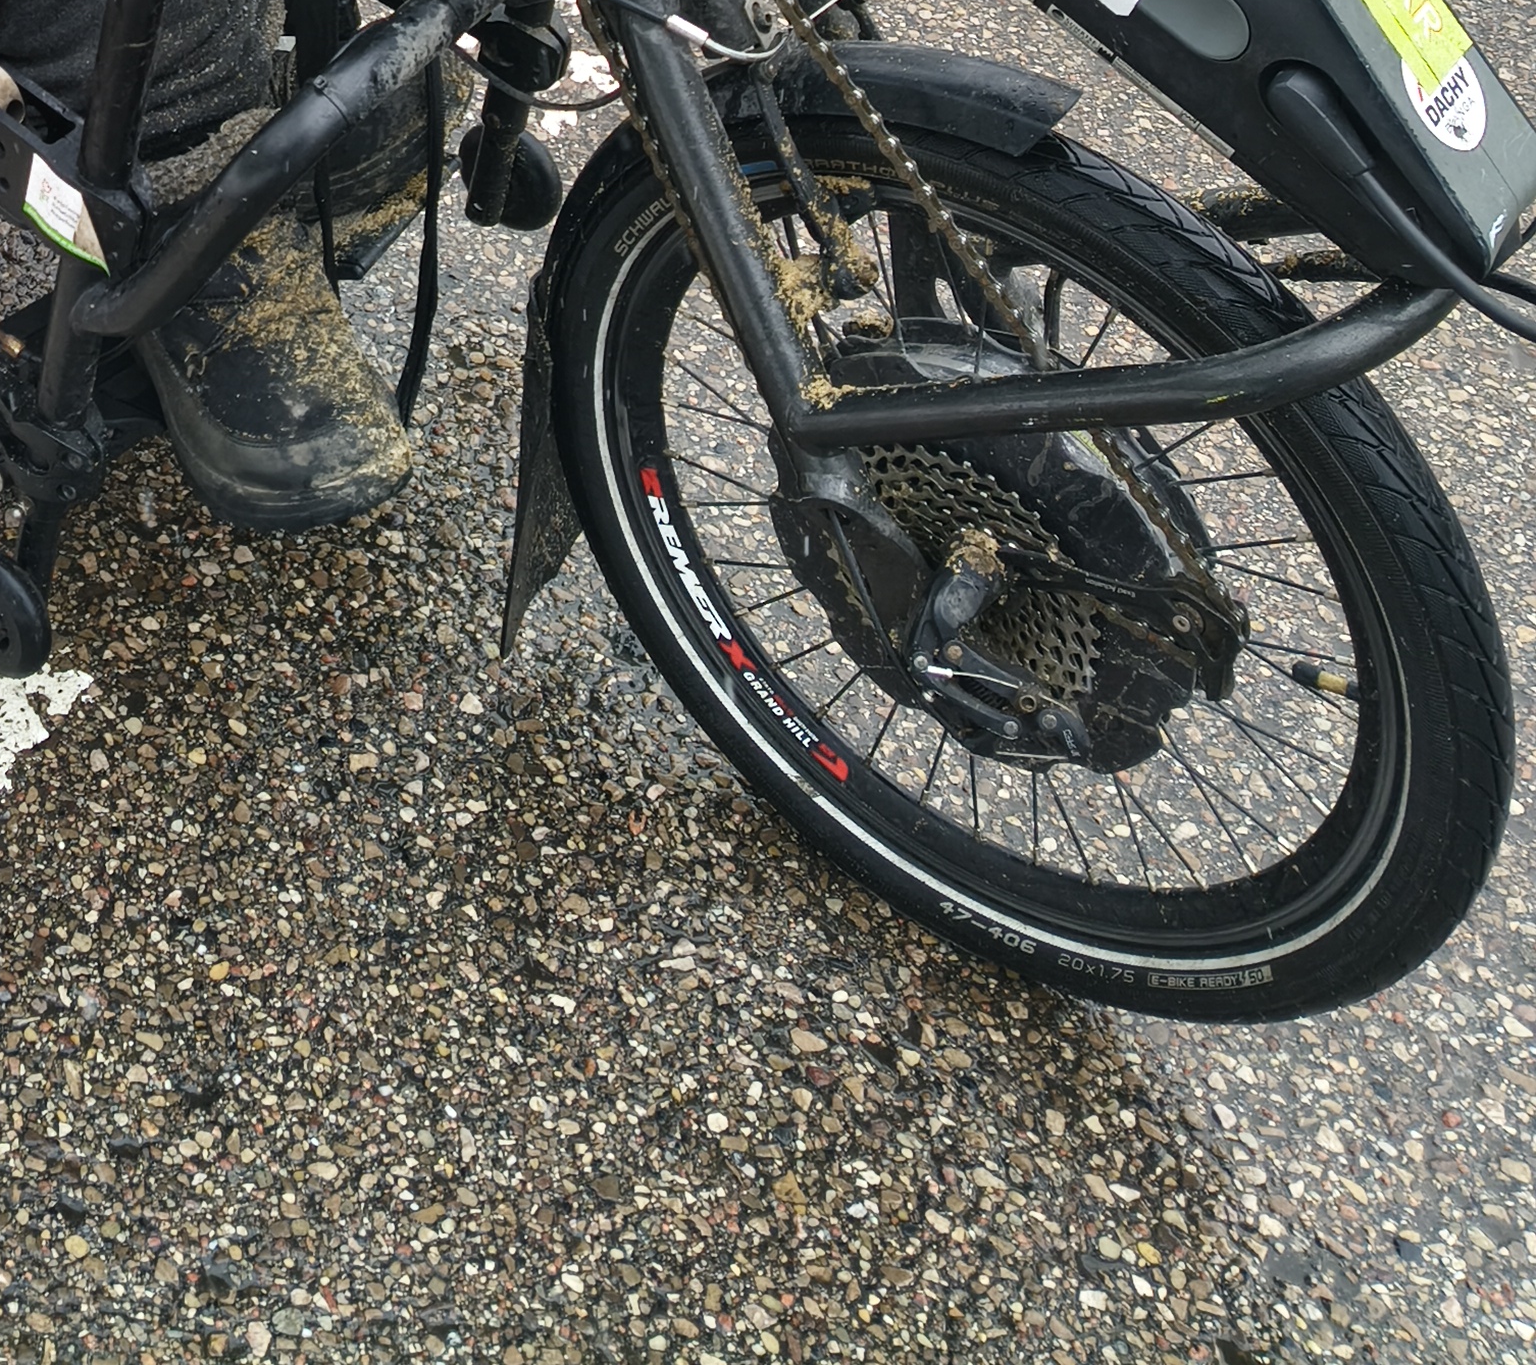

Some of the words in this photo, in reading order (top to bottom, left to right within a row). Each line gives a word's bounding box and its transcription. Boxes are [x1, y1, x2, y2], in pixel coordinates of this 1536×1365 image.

[1424, 66, 1471, 128] DACHY
[614, 197, 672, 258] SCHWAL
[742, 671, 785, 718] GRAND
[782, 715, 812, 749] HILL
[939, 900, 1037, 956] 47-406
[1057, 952, 1136, 985] 20x1.75
[1150, 974, 1196, 988] E-BIKE
[1199, 975, 1241, 988] READY
[1249, 971, 1265, 984] 50
